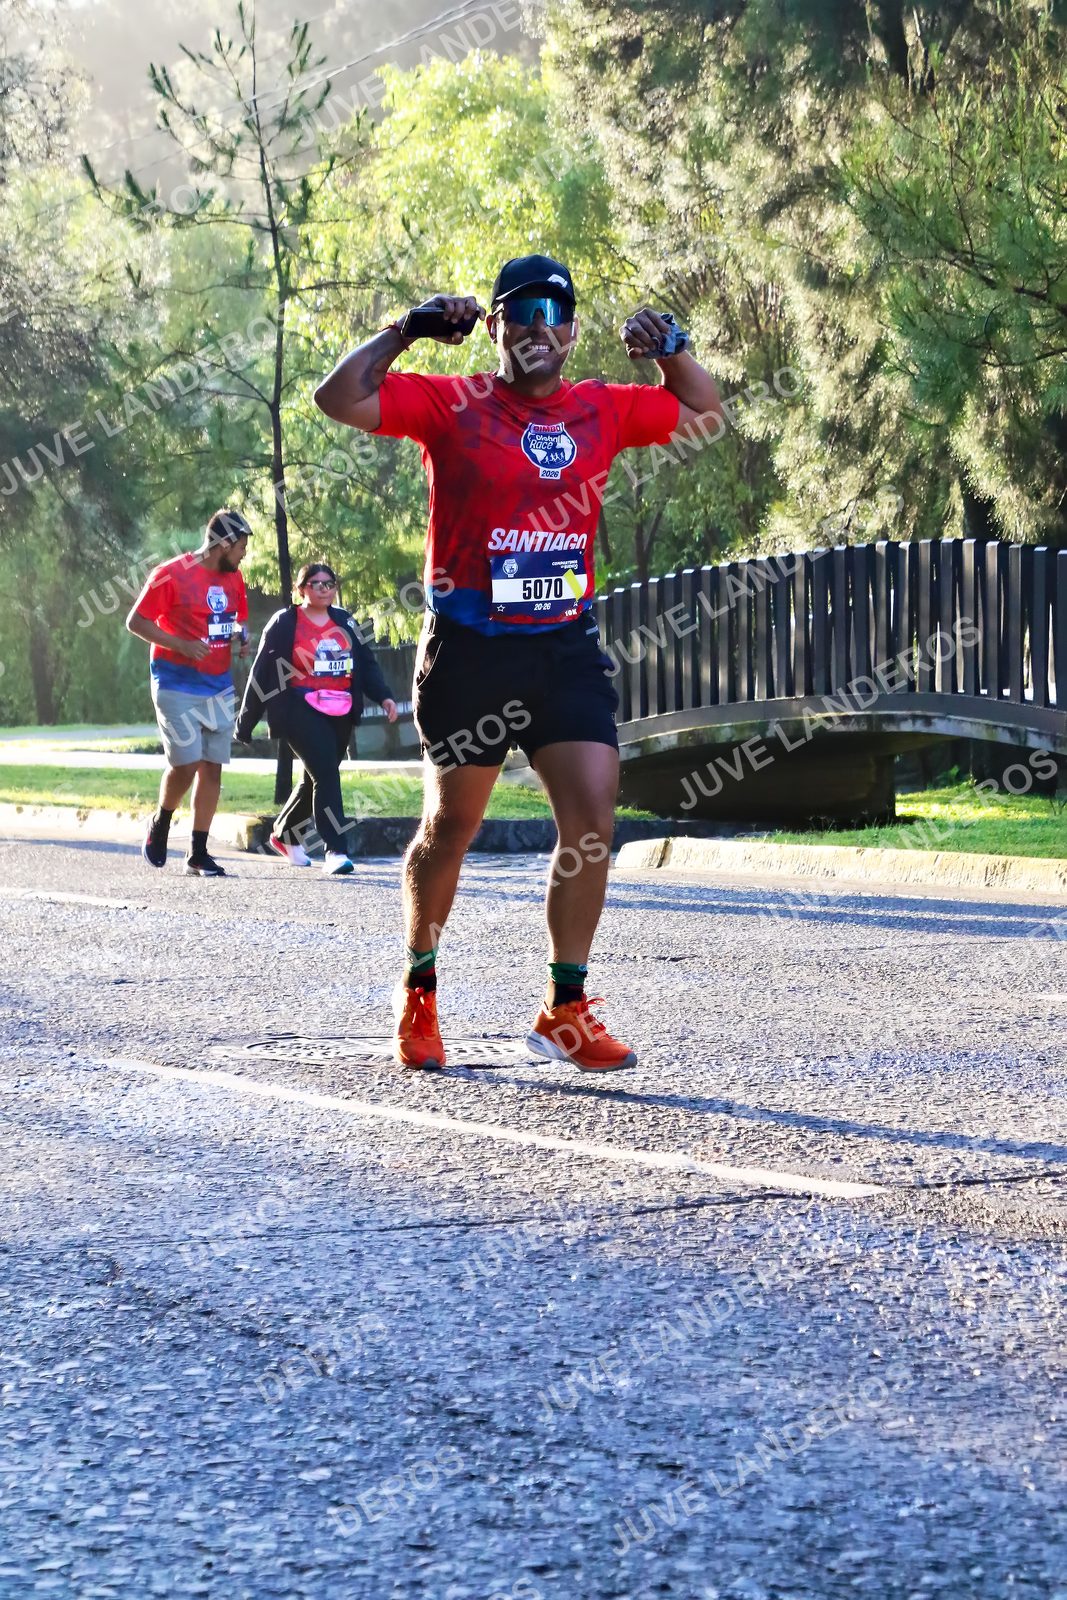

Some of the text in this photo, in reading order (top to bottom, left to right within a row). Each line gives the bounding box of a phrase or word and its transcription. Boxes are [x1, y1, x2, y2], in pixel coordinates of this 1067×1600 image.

[529, 439, 553, 450] Race
[541, 470, 559, 478] 2026
[488, 528, 588, 552] SANTIAGO
[522, 578, 563, 600] 5070
[565, 609, 577, 617] 10K
